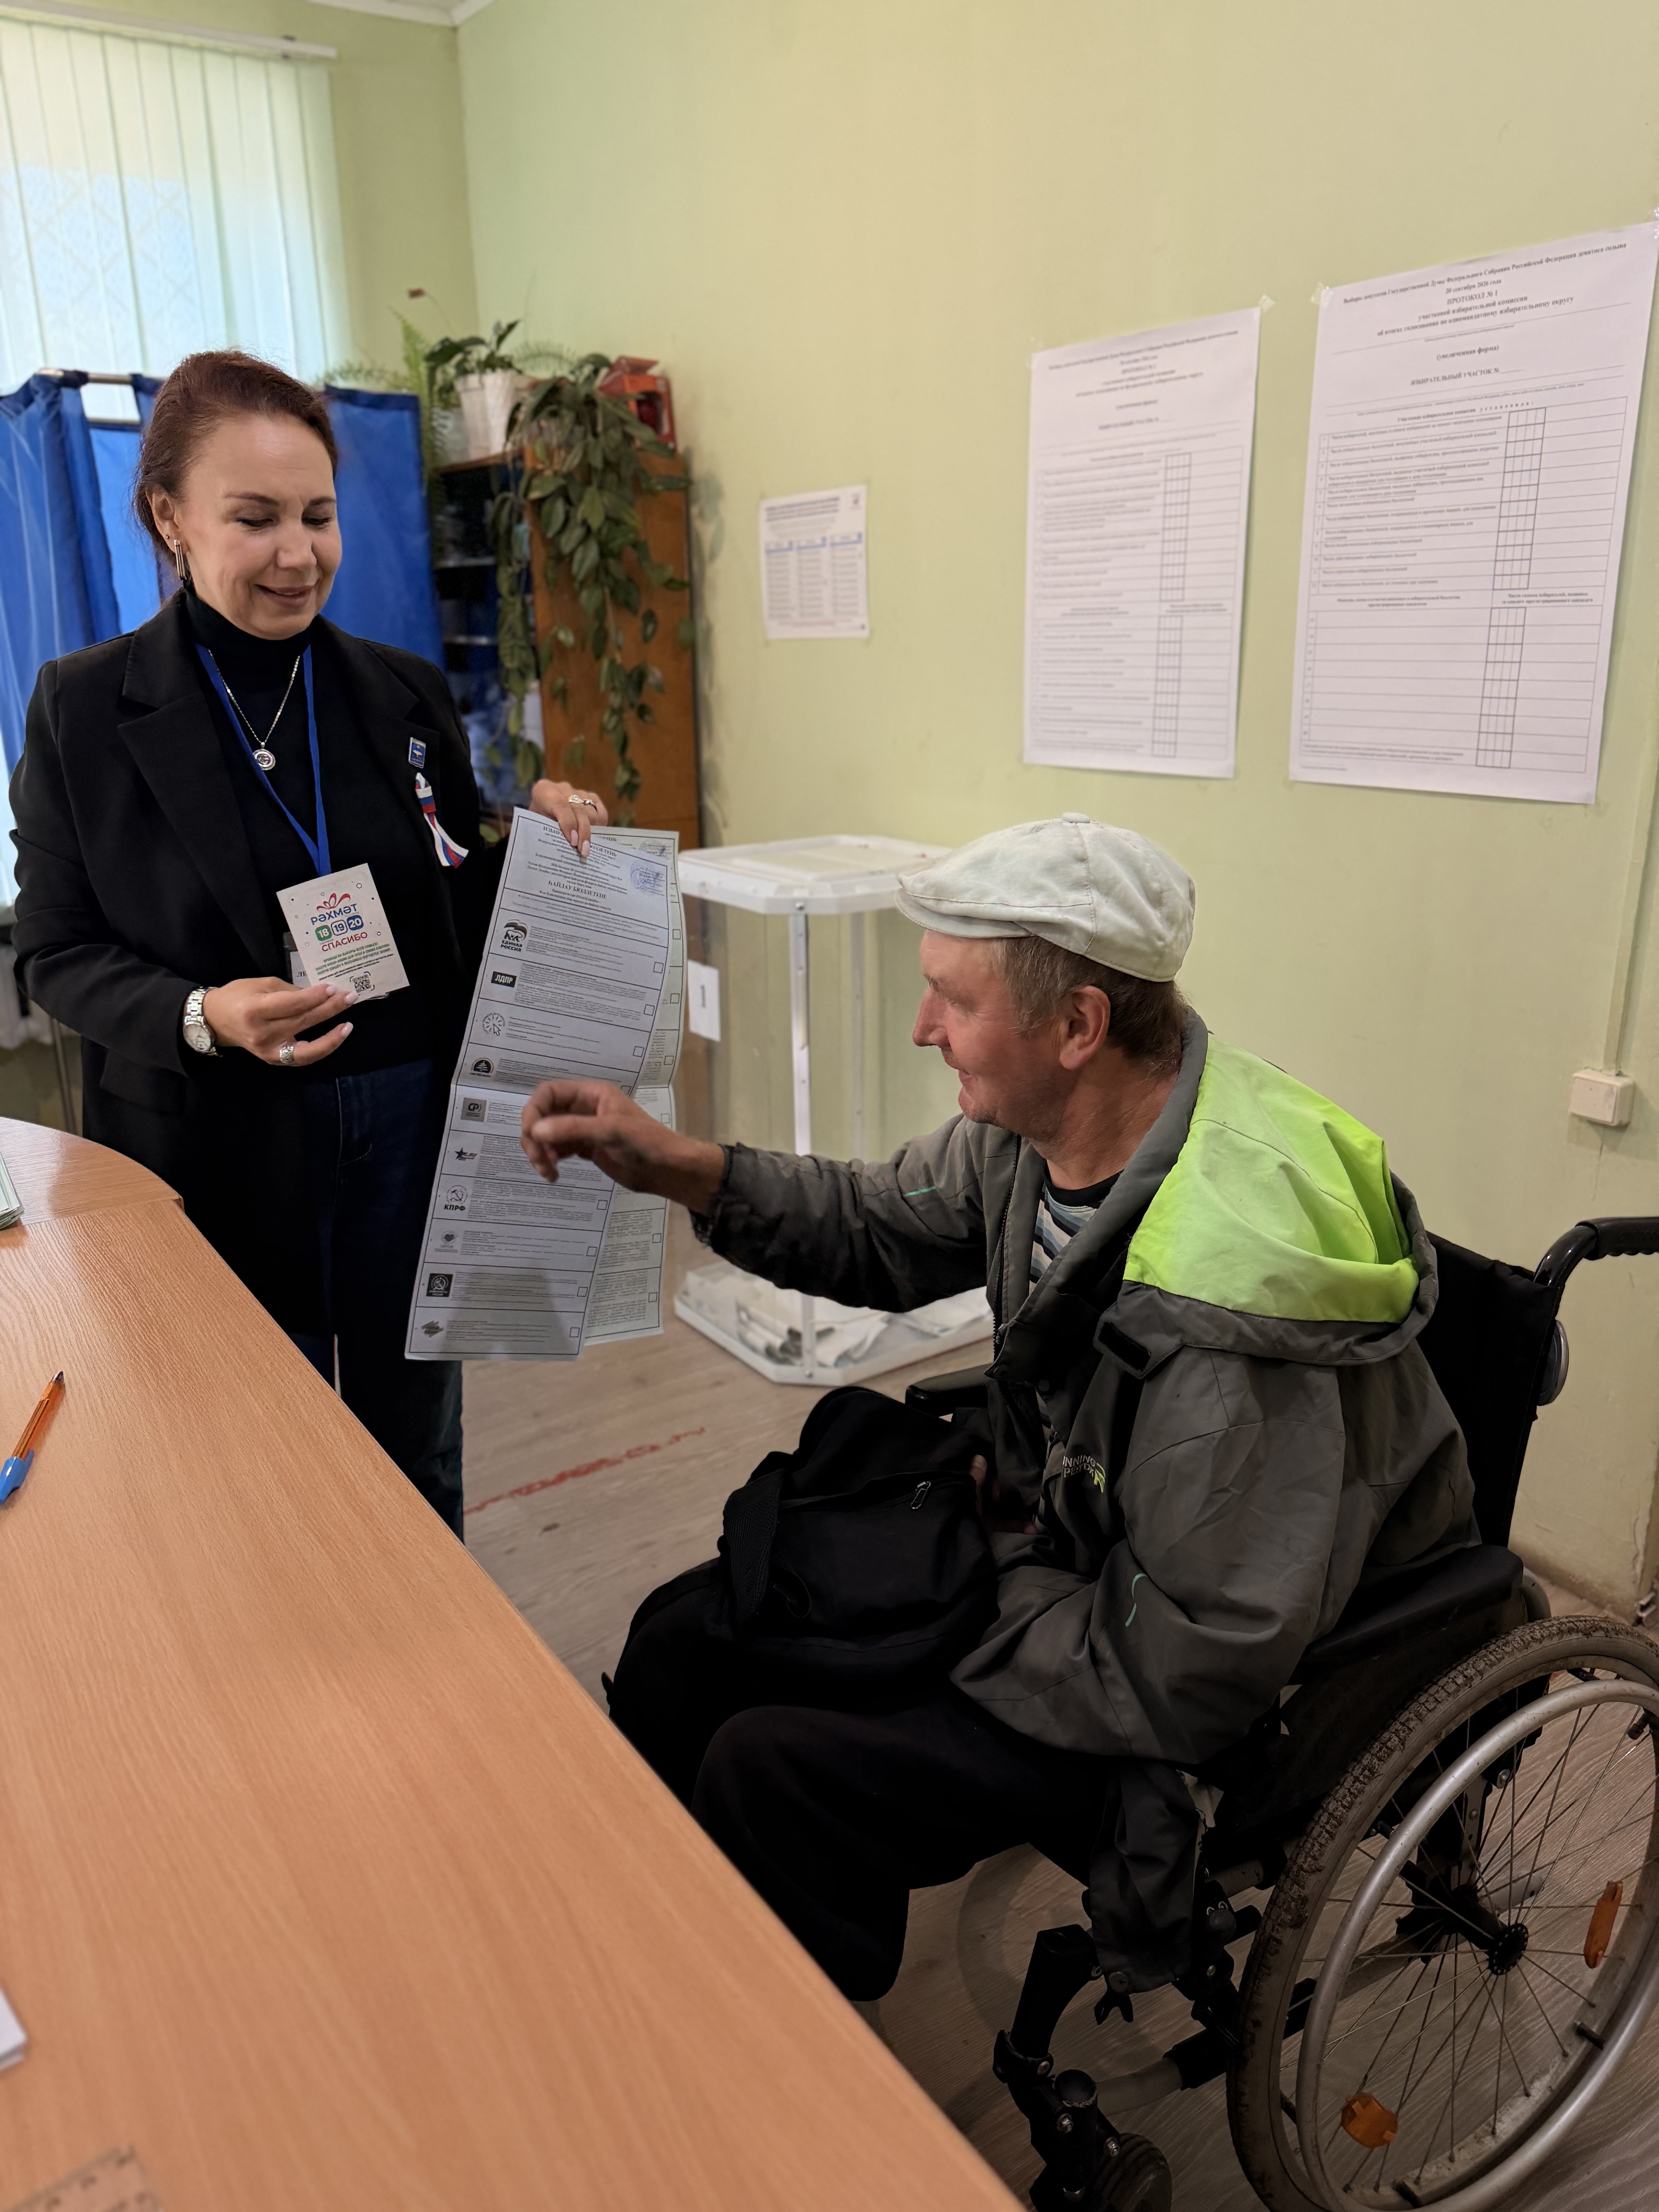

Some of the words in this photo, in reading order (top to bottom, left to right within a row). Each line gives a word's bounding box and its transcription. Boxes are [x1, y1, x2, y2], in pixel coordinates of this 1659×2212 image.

[1452, 284, 1476, 292] сентября
[1447, 292, 1485, 305] ПРОТОКОЛ
[1404, 321, 1439, 331] голосования
[1448, 311, 1497, 323] одномандатному
[1499, 301, 1550, 314] избирательному
[1551, 296, 1574, 306] округу
[1419, 309, 1450, 321] участковой
[1451, 301, 1496, 314] избирательной
[1498, 296, 1527, 306] комиссии
[1436, 349, 1476, 361] (увеличенная
[1477, 344, 1499, 354] форма)
[1411, 371, 1462, 385] ИЗБИРАТЕЛЬНЫЙ
[1463, 368, 1492, 378] УЧАСТОК
[543, 826, 565, 836] ИЗБИРА
[311, 903, 357, 925] РӘХМӘТ
[318, 928, 328, 938] 18
[334, 923, 344, 933] 19
[350, 918, 362, 928] 20
[321, 932, 368, 952] СПАСИБО
[501, 940, 522, 948] ЕДИНАЯ
[495, 974, 513, 984] ЛДПР
[700, 984, 706, 1008] 1
